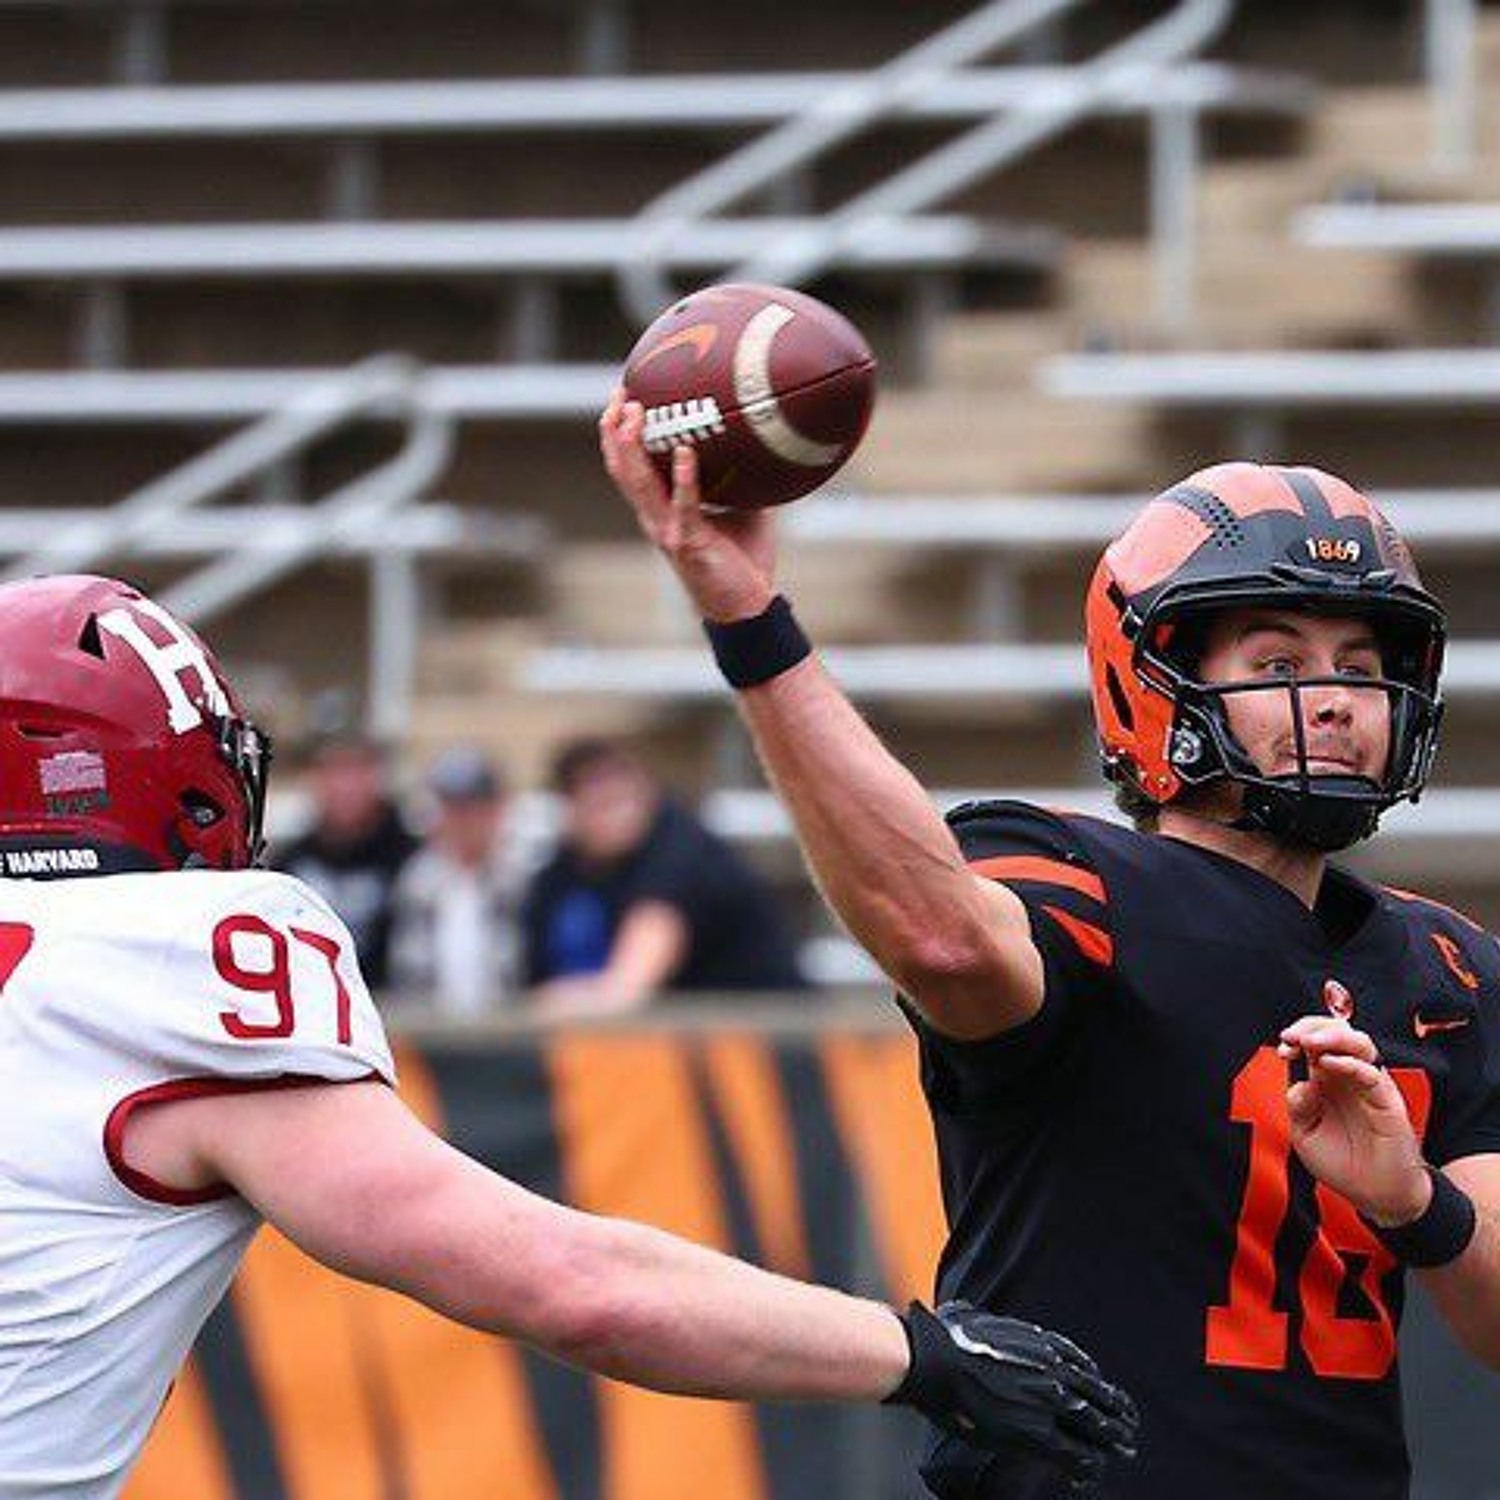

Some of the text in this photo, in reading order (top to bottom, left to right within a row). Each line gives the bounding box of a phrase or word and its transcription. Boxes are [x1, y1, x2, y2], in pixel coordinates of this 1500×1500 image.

[1305, 537, 1360, 562] 1869
[97, 588, 232, 735] H
[5, 849, 99, 873] HARVARD
[212, 914, 352, 1047] 97
